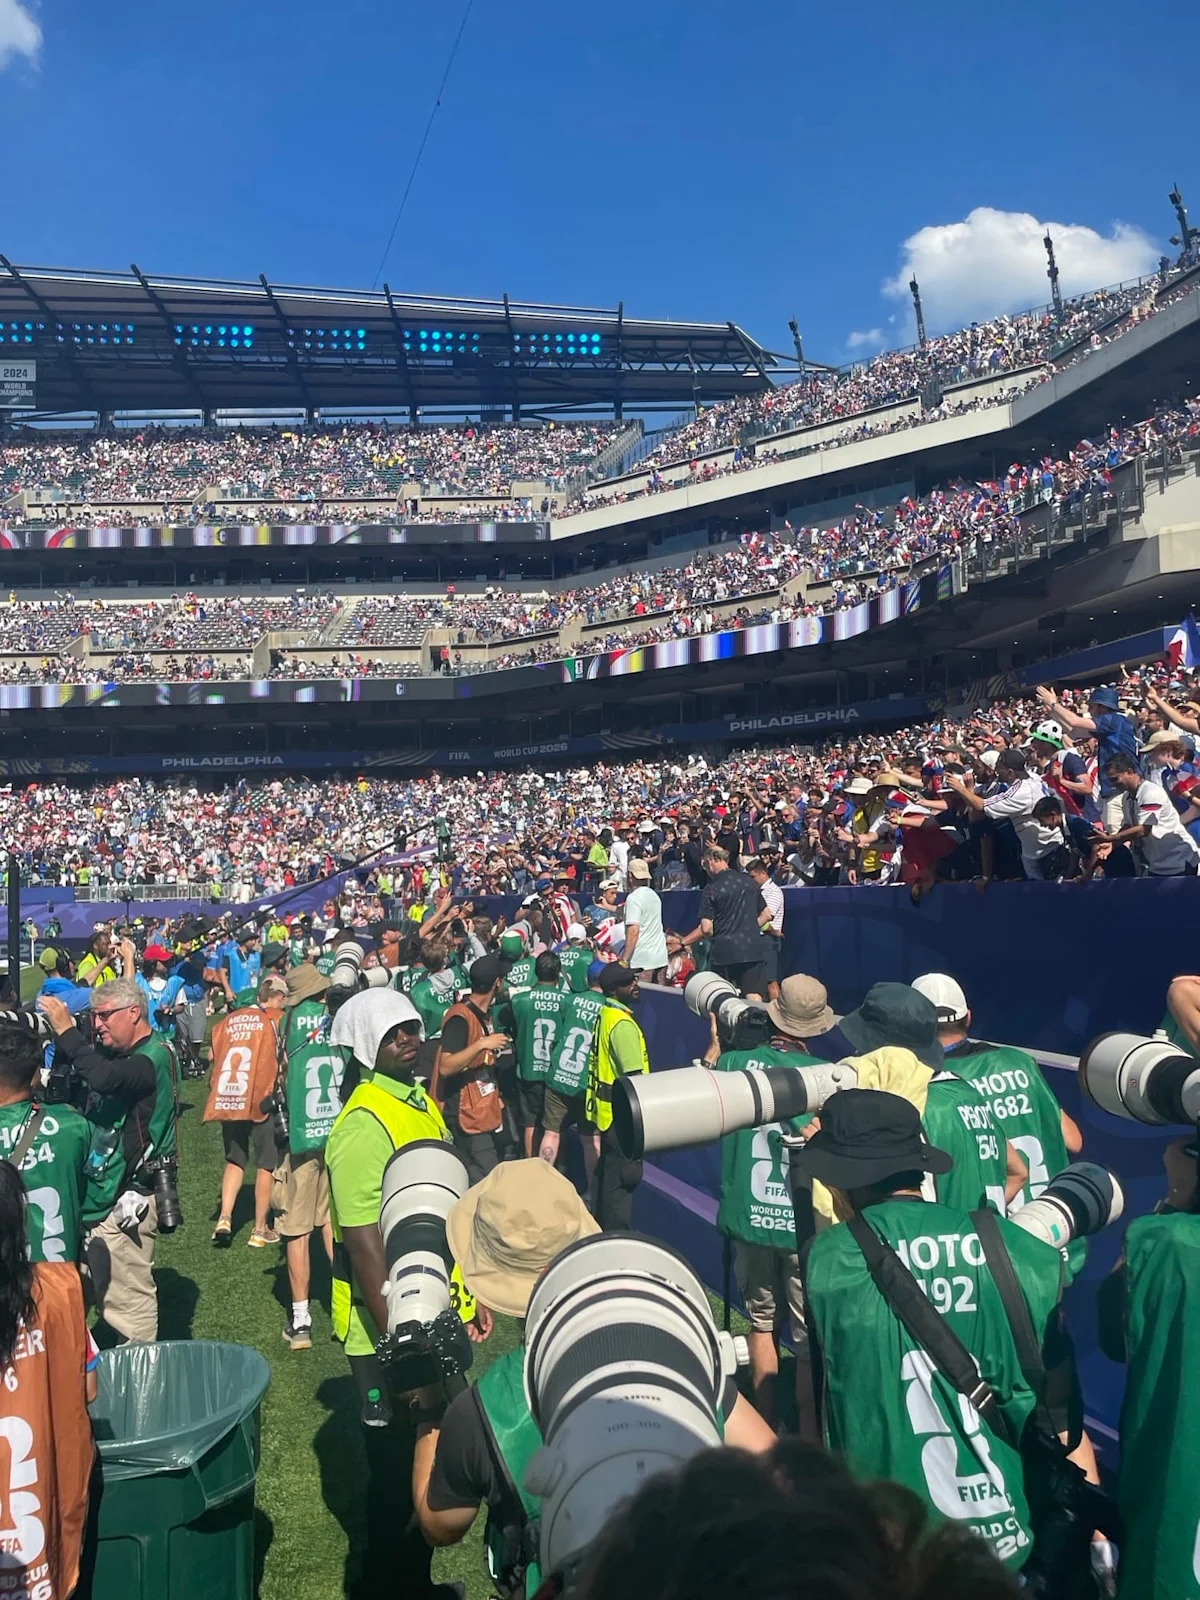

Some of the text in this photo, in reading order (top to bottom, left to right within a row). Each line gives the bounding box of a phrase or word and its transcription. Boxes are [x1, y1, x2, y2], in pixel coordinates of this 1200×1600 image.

[3, 368, 28, 378] 2024
[3, 382, 27, 390] WORLD
[729, 708, 860, 731] PHILADELPHIA
[448, 742, 568, 760] FIFA WORLD CUP 2026
[162, 756, 284, 767] PHILADELPHIA
[534, 1000, 560, 1012] 0559
[228, 1014, 261, 1025] MEDIA
[967, 1069, 1030, 1097] HOTO
[315, 1104, 333, 1114] FIFA
[764, 1186, 788, 1198] FIFA
[750, 1204, 782, 1217] WORLD
[750, 1214, 797, 1233] 2026
[888, 1233, 988, 1271] HOTO
[957, 1482, 1004, 1503] FIFA
[20, 1562, 49, 1585] CUP
